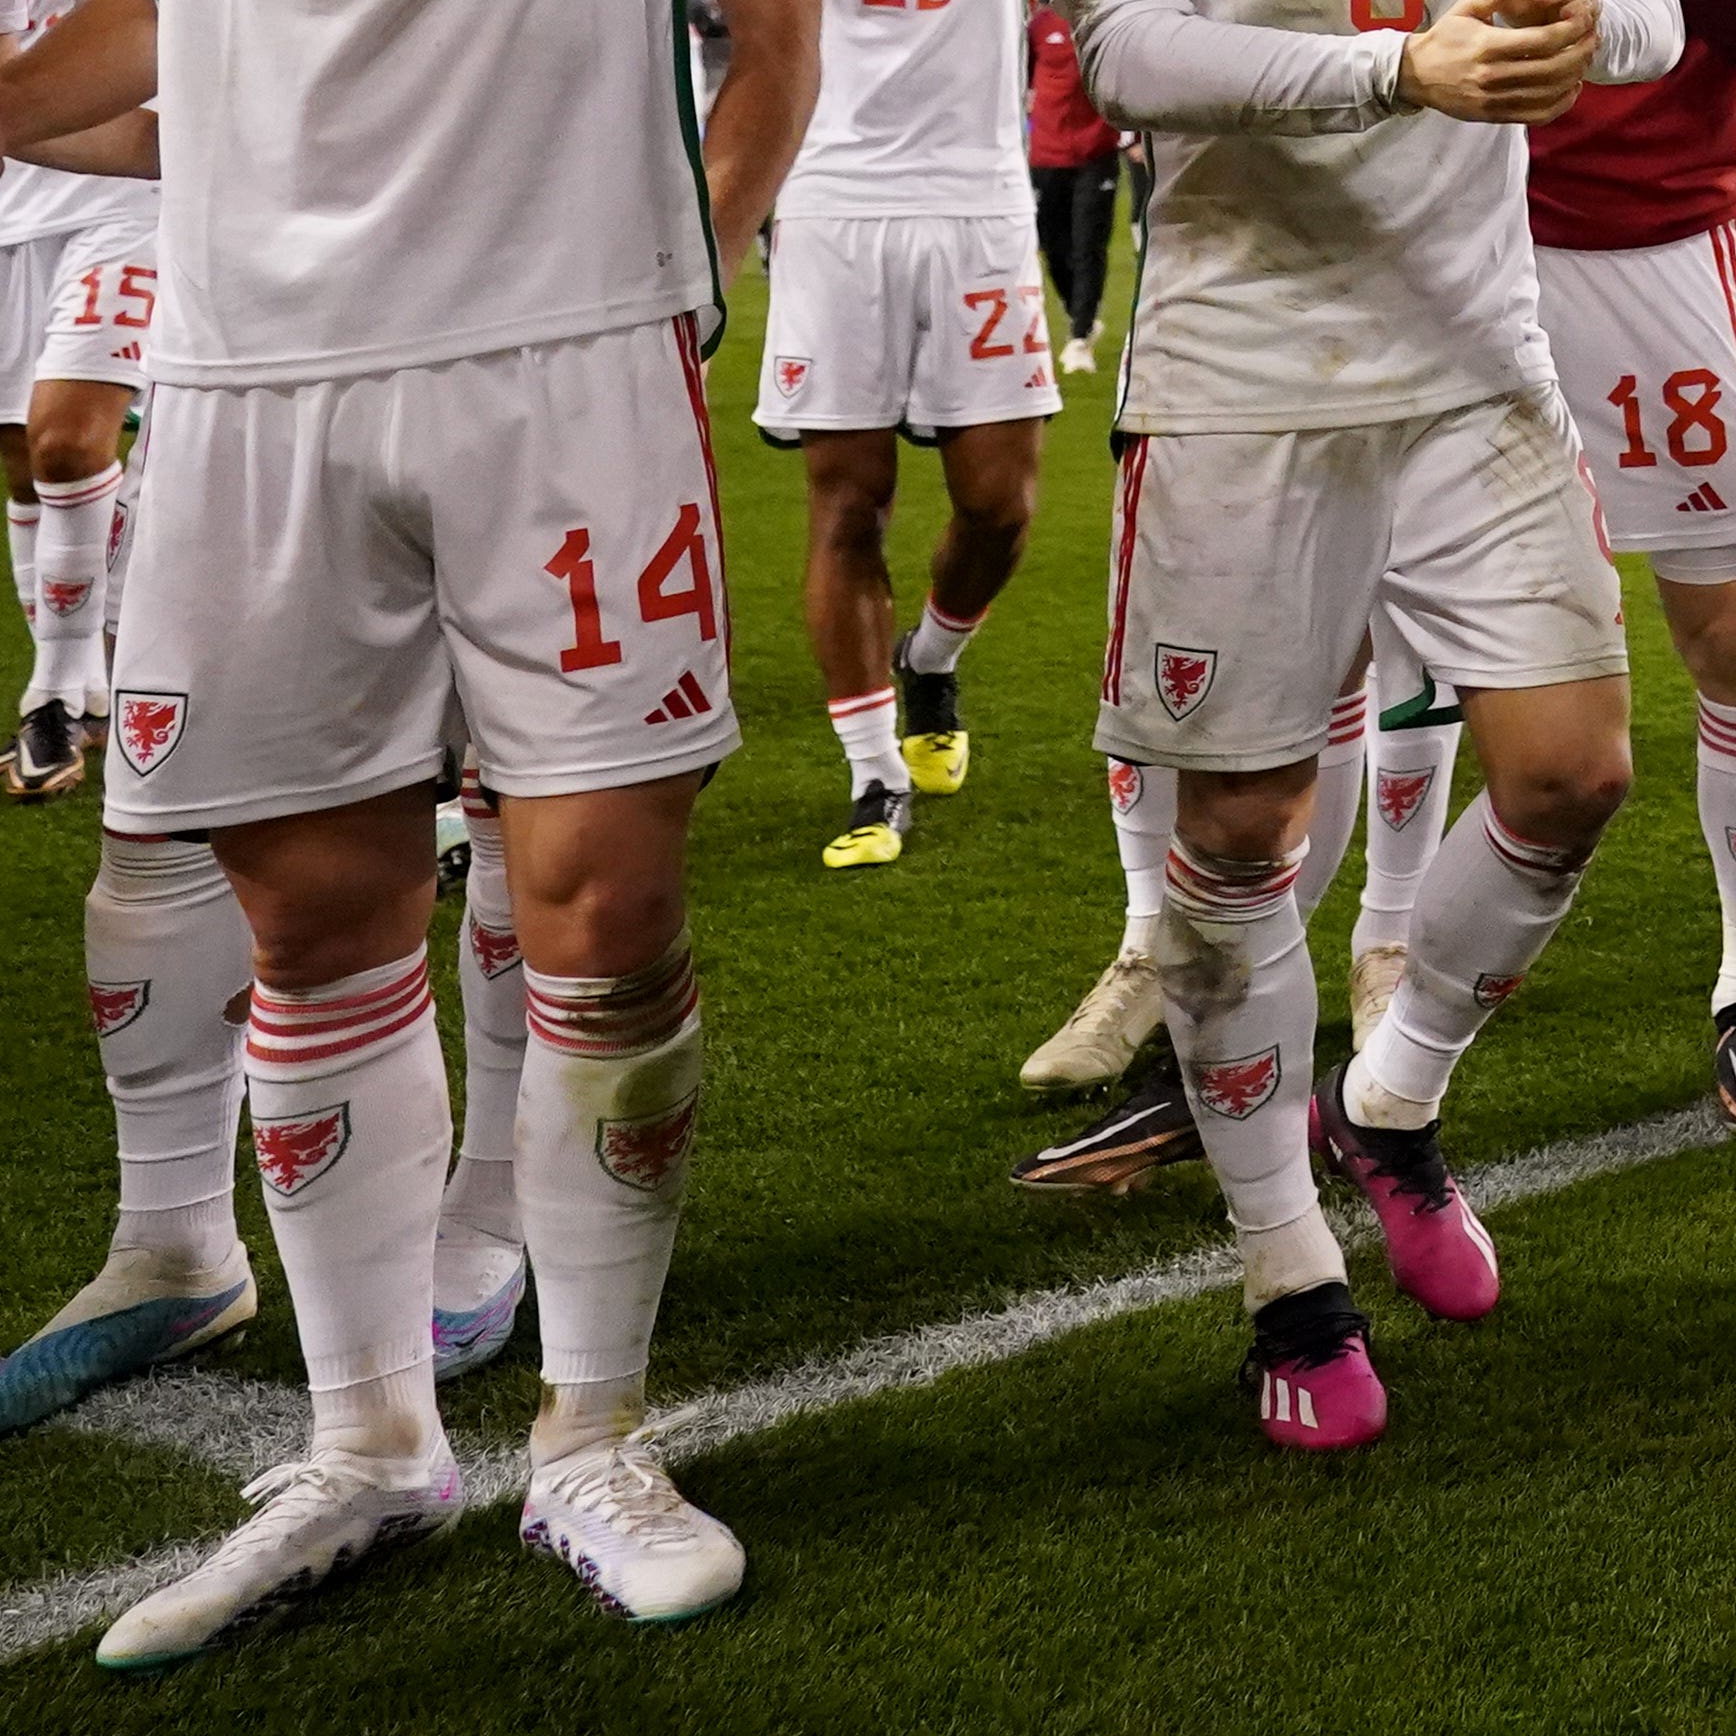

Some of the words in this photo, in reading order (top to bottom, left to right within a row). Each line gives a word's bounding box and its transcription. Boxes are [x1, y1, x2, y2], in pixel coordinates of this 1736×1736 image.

[73, 264, 158, 329] 15
[963, 285, 1049, 360] 22
[1606, 367, 1727, 469] 18
[544, 502, 718, 674] 14
